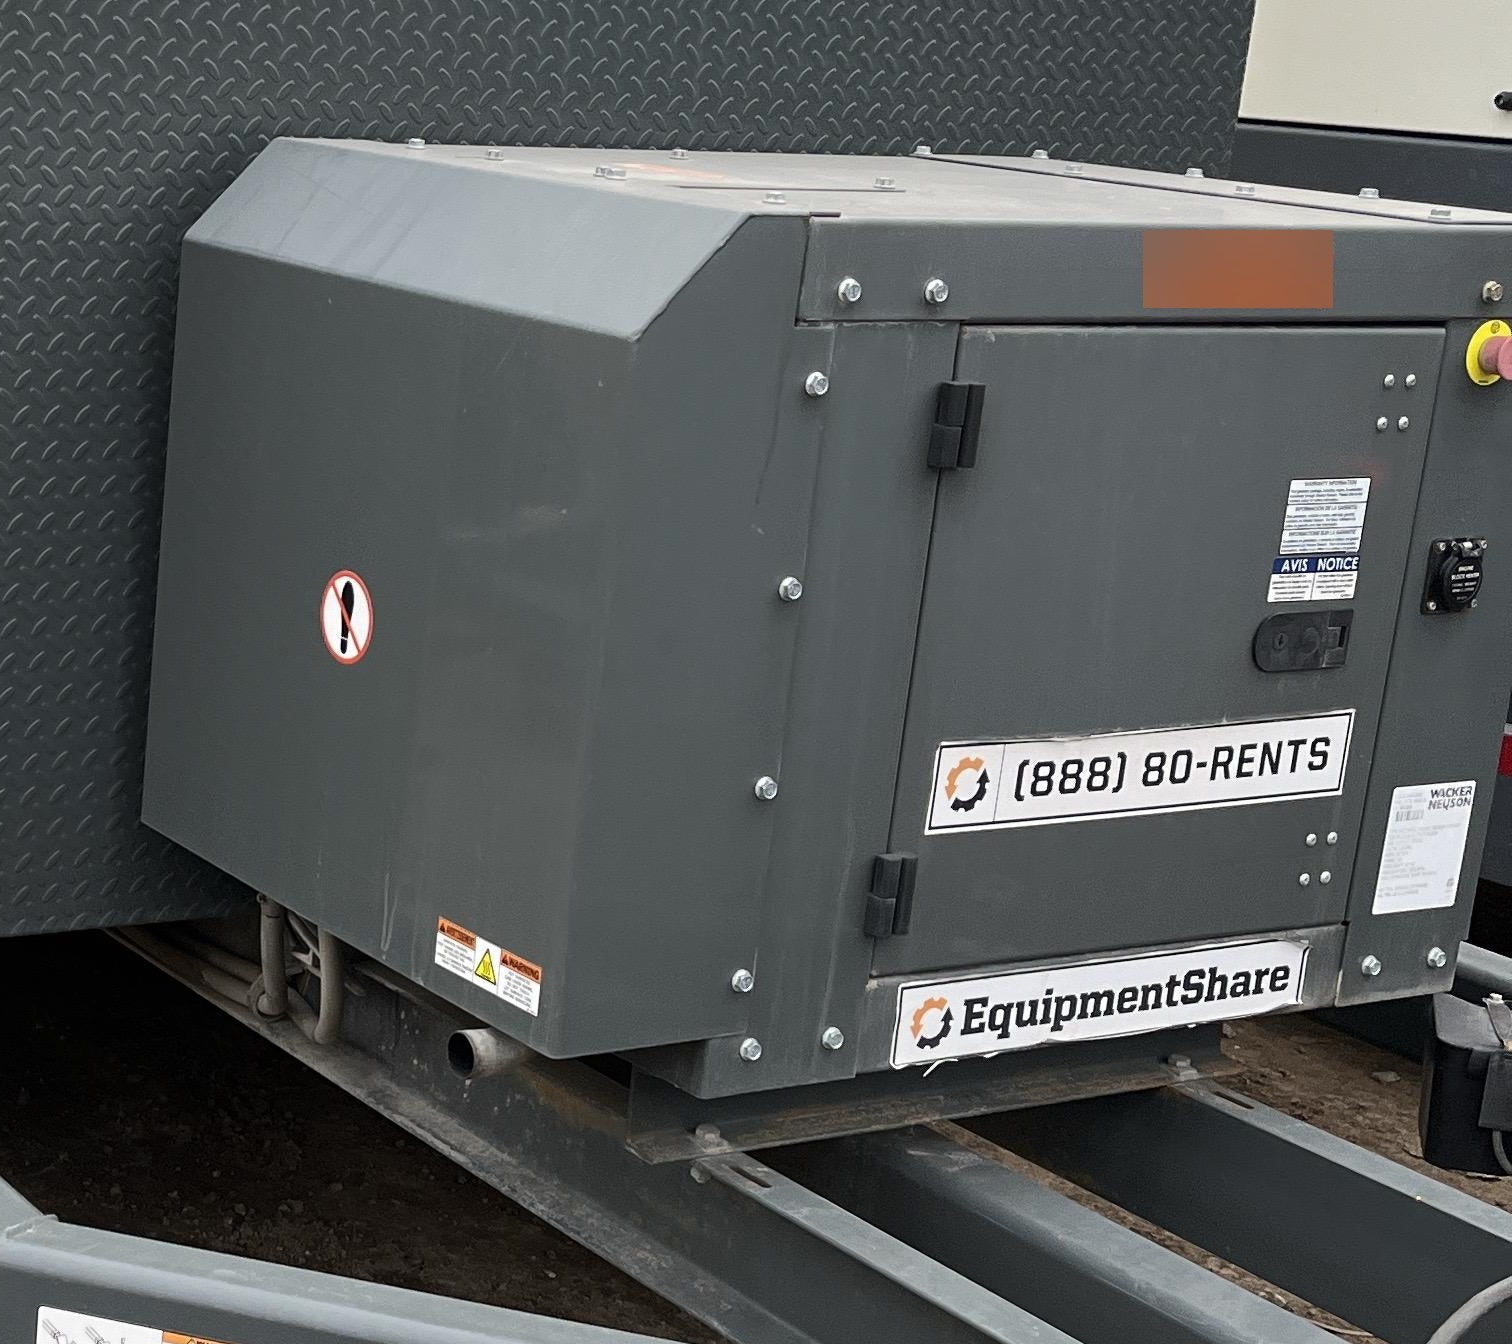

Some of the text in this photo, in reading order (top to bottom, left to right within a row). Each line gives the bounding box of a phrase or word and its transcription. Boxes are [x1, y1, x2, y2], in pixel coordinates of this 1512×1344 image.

[1281, 557, 1359, 572] AVIS NOTICE
[1014, 737, 1331, 802] (888) 80-RENTS
[1431, 786, 1473, 799] WACKER
[960, 964, 1290, 1039] EquipmentShare
